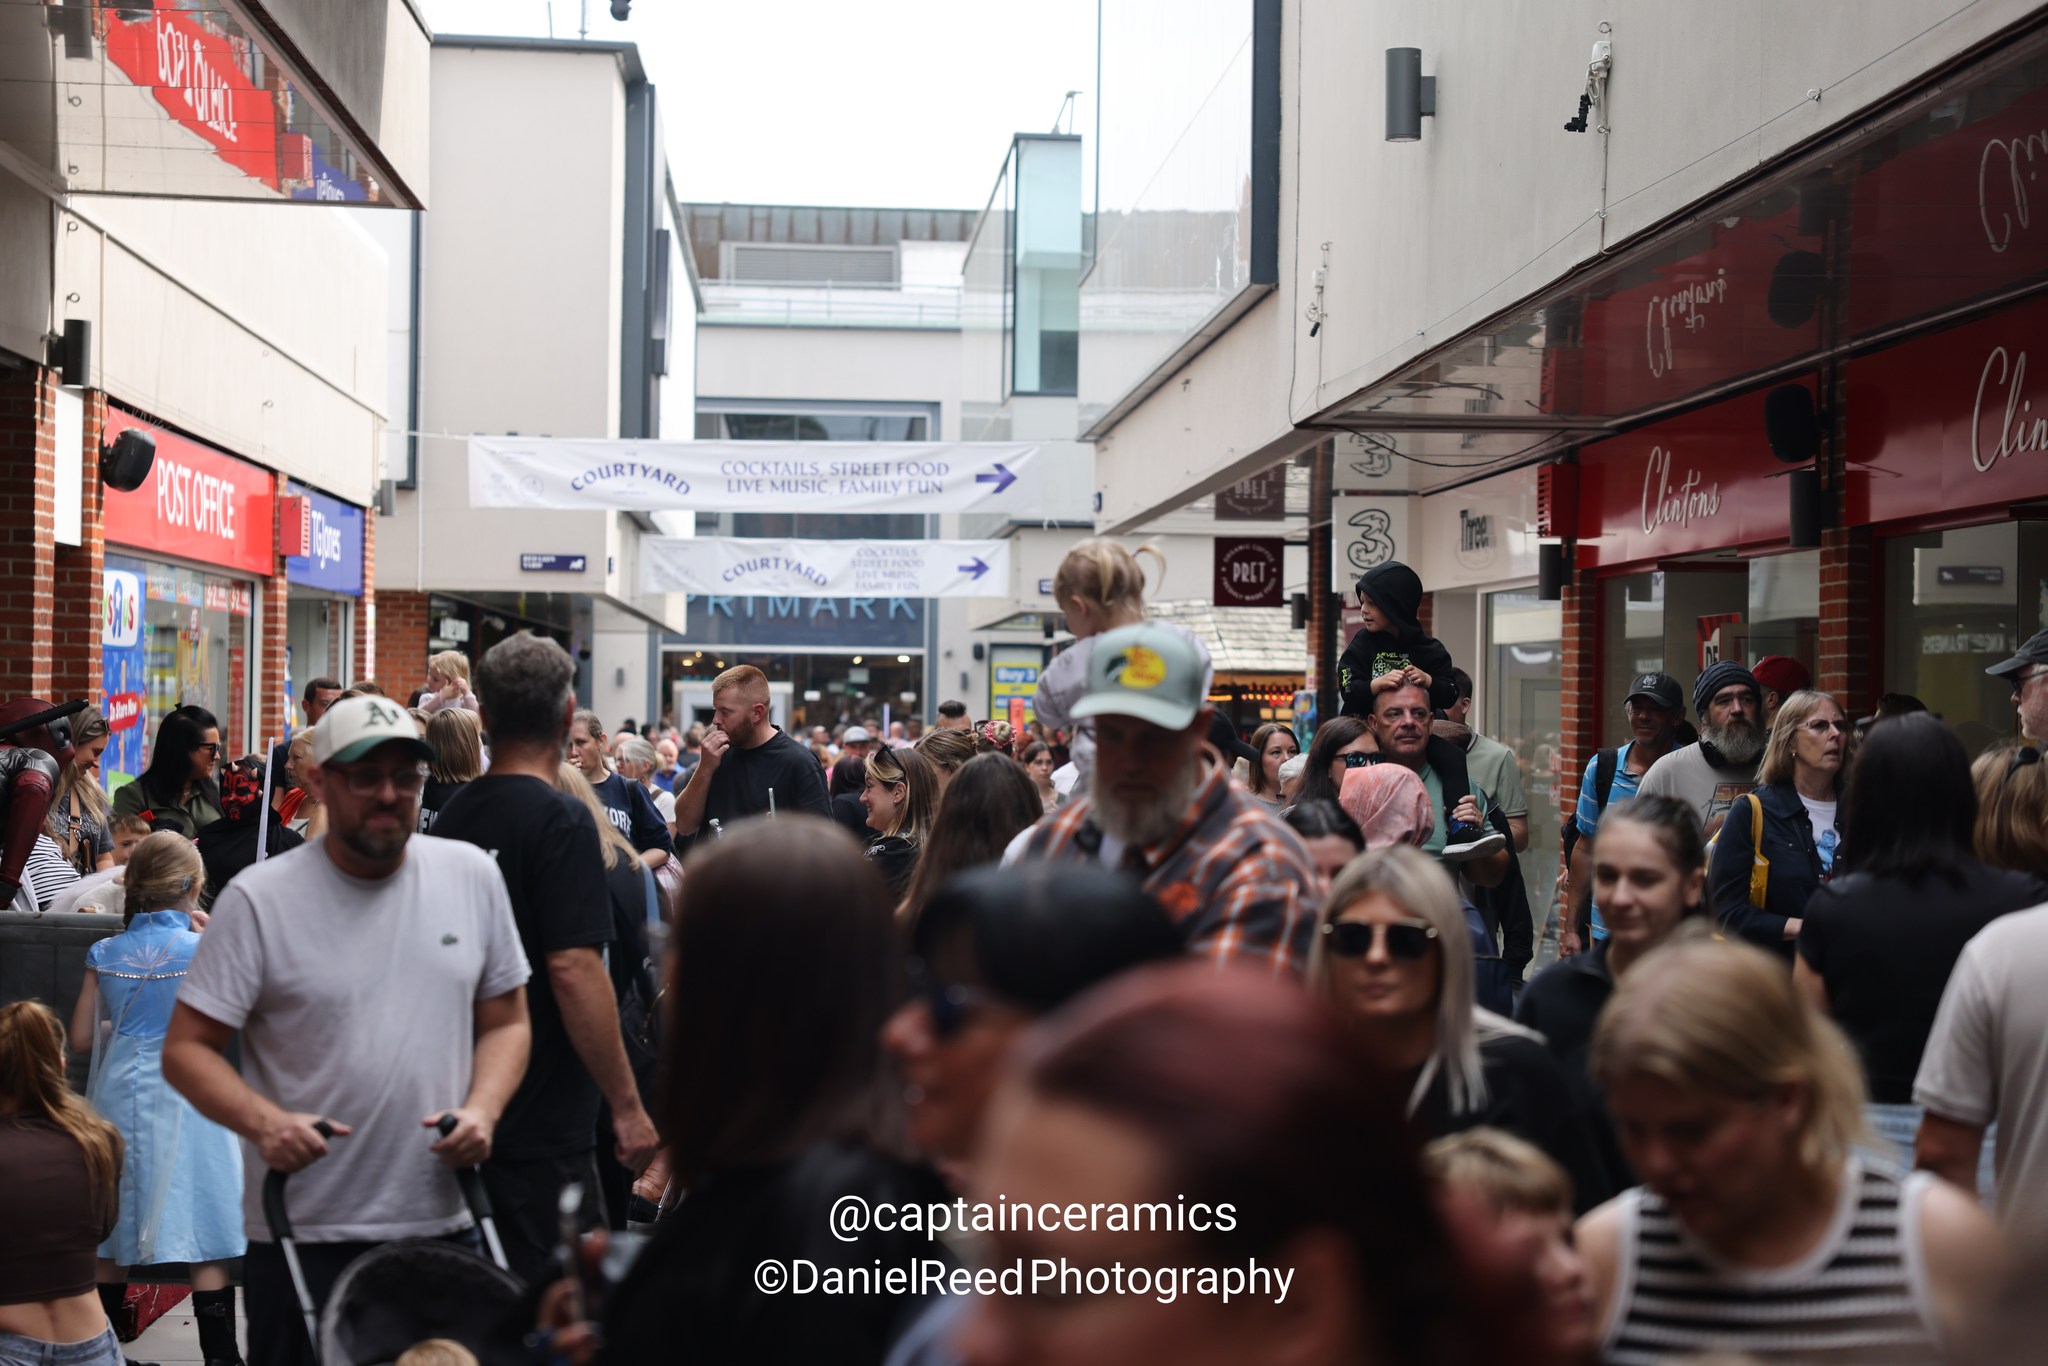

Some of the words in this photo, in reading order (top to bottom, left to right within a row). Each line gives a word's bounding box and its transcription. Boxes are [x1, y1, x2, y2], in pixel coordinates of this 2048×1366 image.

[570, 461, 692, 497] COURTYARD
[721, 460, 824, 478] COCKTAILS,
[829, 462, 891, 477] STREET
[897, 462, 949, 477] FOOD
[157, 457, 192, 528] POST
[193, 470, 235, 540] OFFICE
[727, 479, 764, 494] LIVE
[770, 479, 833, 496] MUSIC,
[839, 480, 903, 496] FAMILY
[908, 480, 943, 494] FUN
[1642, 446, 1721, 535] Clintons
[1347, 508, 1396, 570] 3
[721, 556, 828, 588] COURTYARD
[1232, 561, 1267, 583] PRET
[687, 594, 917, 620] RIMARK
[997, 668, 1025, 683] Buy
